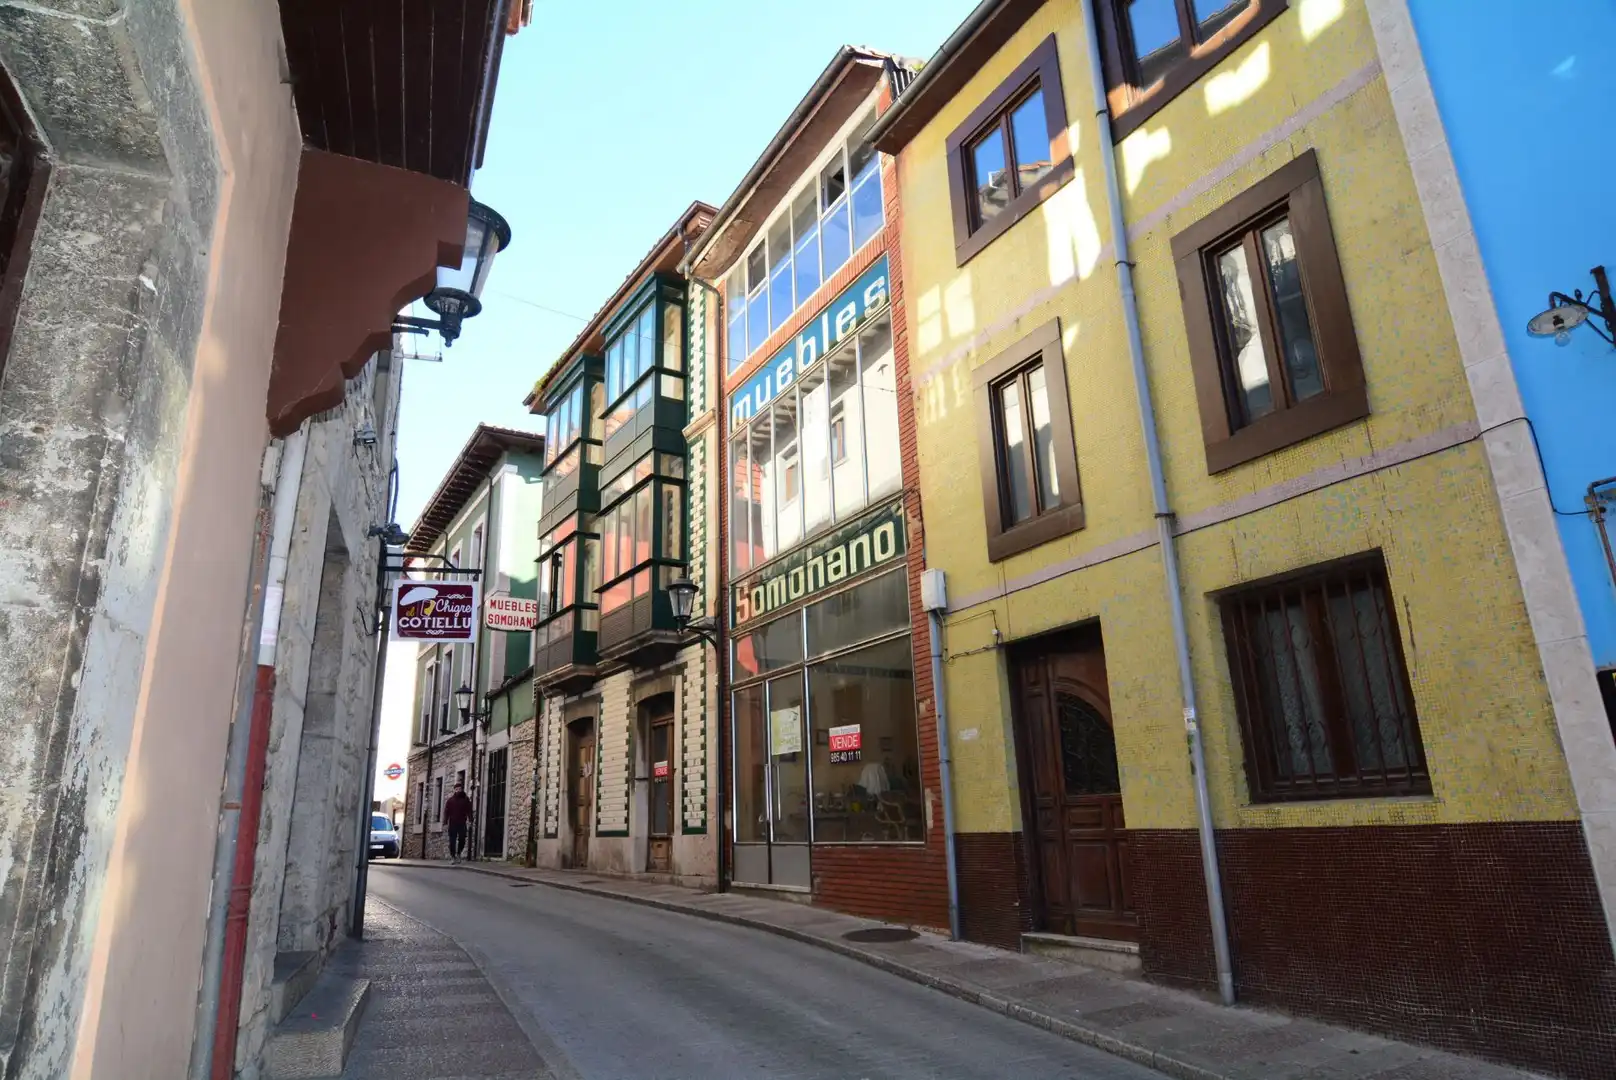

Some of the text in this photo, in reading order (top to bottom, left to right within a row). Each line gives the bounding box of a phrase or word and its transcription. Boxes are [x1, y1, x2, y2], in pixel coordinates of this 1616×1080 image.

[731, 275, 886, 433] muebles
[435, 598, 473, 617] Chigre
[490, 599, 537, 613] MUEBLES
[398, 616, 472, 628] COTIELLU
[831, 734, 859, 750] VENDE
